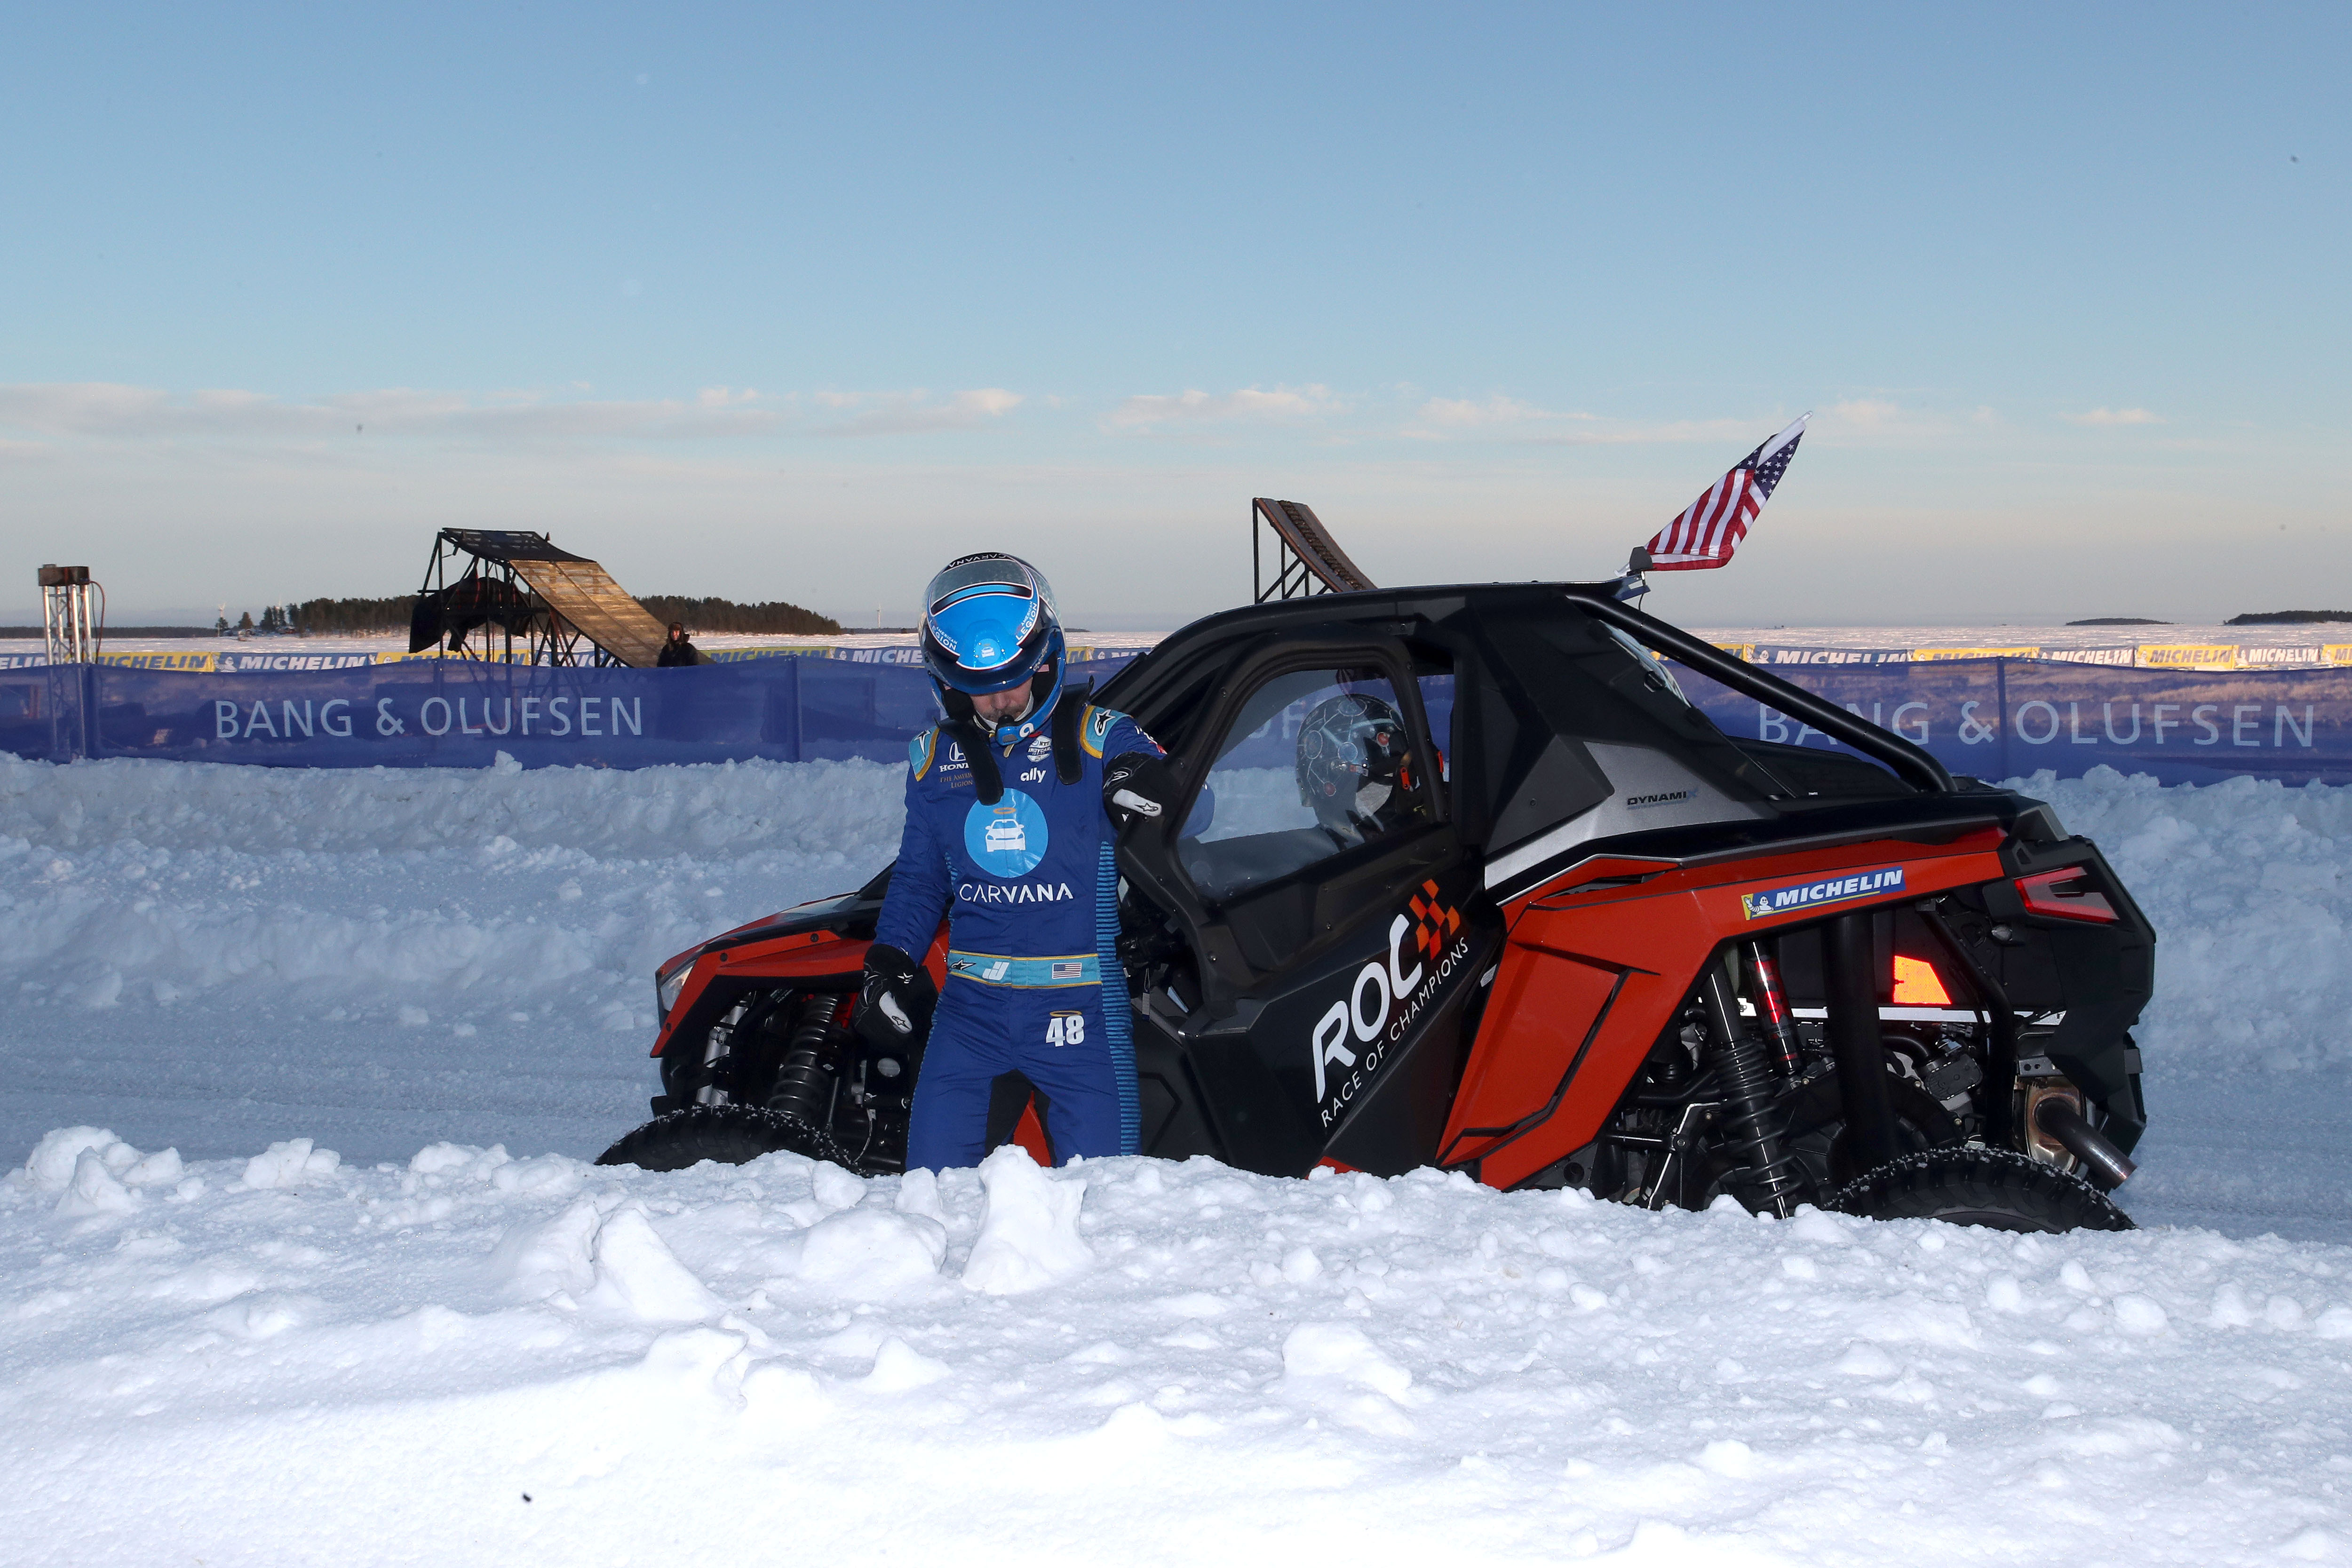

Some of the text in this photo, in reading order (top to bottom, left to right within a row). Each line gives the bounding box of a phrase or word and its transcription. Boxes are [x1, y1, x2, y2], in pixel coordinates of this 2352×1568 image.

[949, 553, 1006, 567] CARVANA
[1016, 603, 1037, 640] LEGION
[929, 619, 957, 651] LEGION
[239, 656, 366, 670] MICHELIN
[2051, 649, 2133, 664] MICHELIN
[2149, 650, 2233, 663] MICHELIN
[2249, 648, 2319, 662] MICHELIN
[215, 697, 642, 738] BANG & OLUFSEN
[1958, 700, 1995, 745] &
[2016, 700, 2313, 747] OLUFSEN
[939, 763, 969, 772] HON
[1020, 767, 1046, 783] ally
[951, 780, 973, 788] LEGION
[959, 883, 1074, 904] CARVANA
[1775, 869, 1903, 907] MICHELIN
[1312, 914, 1422, 1104] ROC
[1045, 1014, 1085, 1047] 48
[1320, 937, 1469, 1128] RACE OF CHAMPIONS
